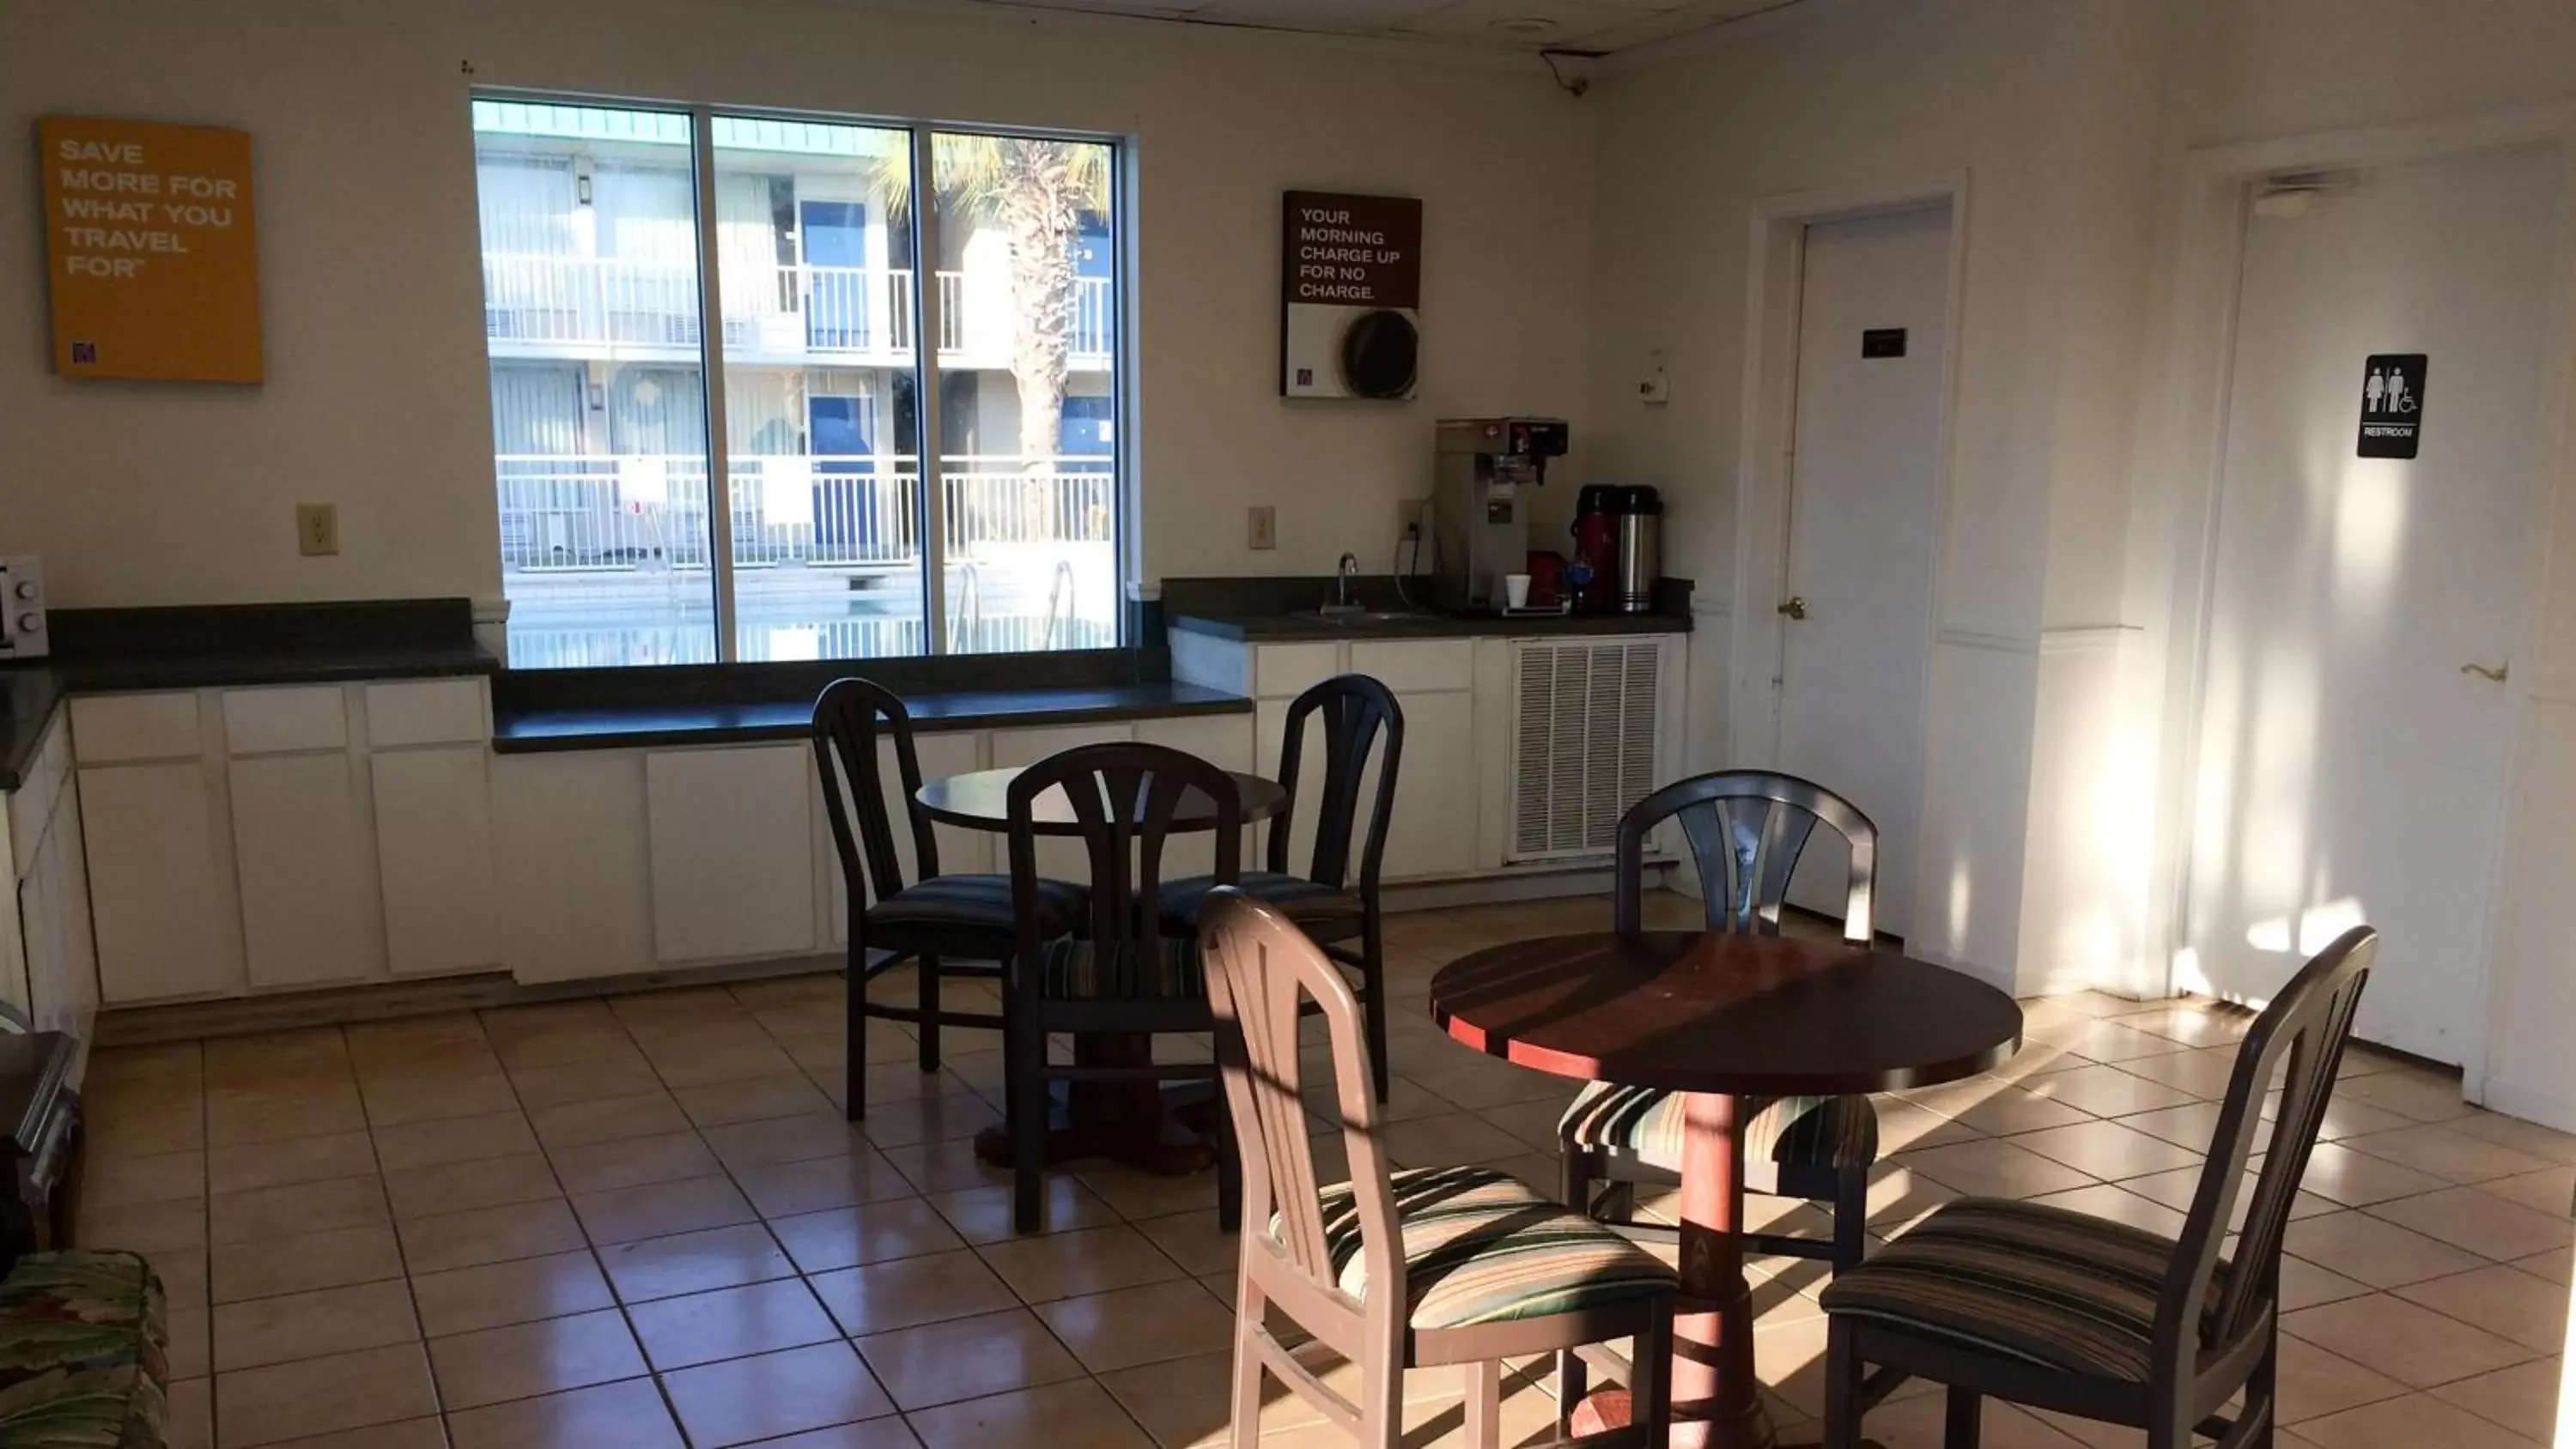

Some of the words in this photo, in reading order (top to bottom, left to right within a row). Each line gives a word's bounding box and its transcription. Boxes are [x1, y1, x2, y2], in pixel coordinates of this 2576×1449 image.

[59, 139, 144, 164] SAVE
[61, 169, 161, 194] MORE
[169, 176, 237, 199] FOR
[62, 198, 153, 222] WHAT
[164, 205, 232, 227] YOU
[1301, 209, 1350, 225] YOUR
[63, 227, 189, 253] TRAVEL
[1301, 227, 1384, 245] MORNING
[1300, 246, 1372, 263] CHARGE
[1377, 251, 1400, 264] UP
[1299, 264, 1335, 279] FOR
[1340, 267, 1365, 282] NO
[1299, 283, 1375, 300] CHARGE.
[2364, 427, 2413, 437] RESTROOM
